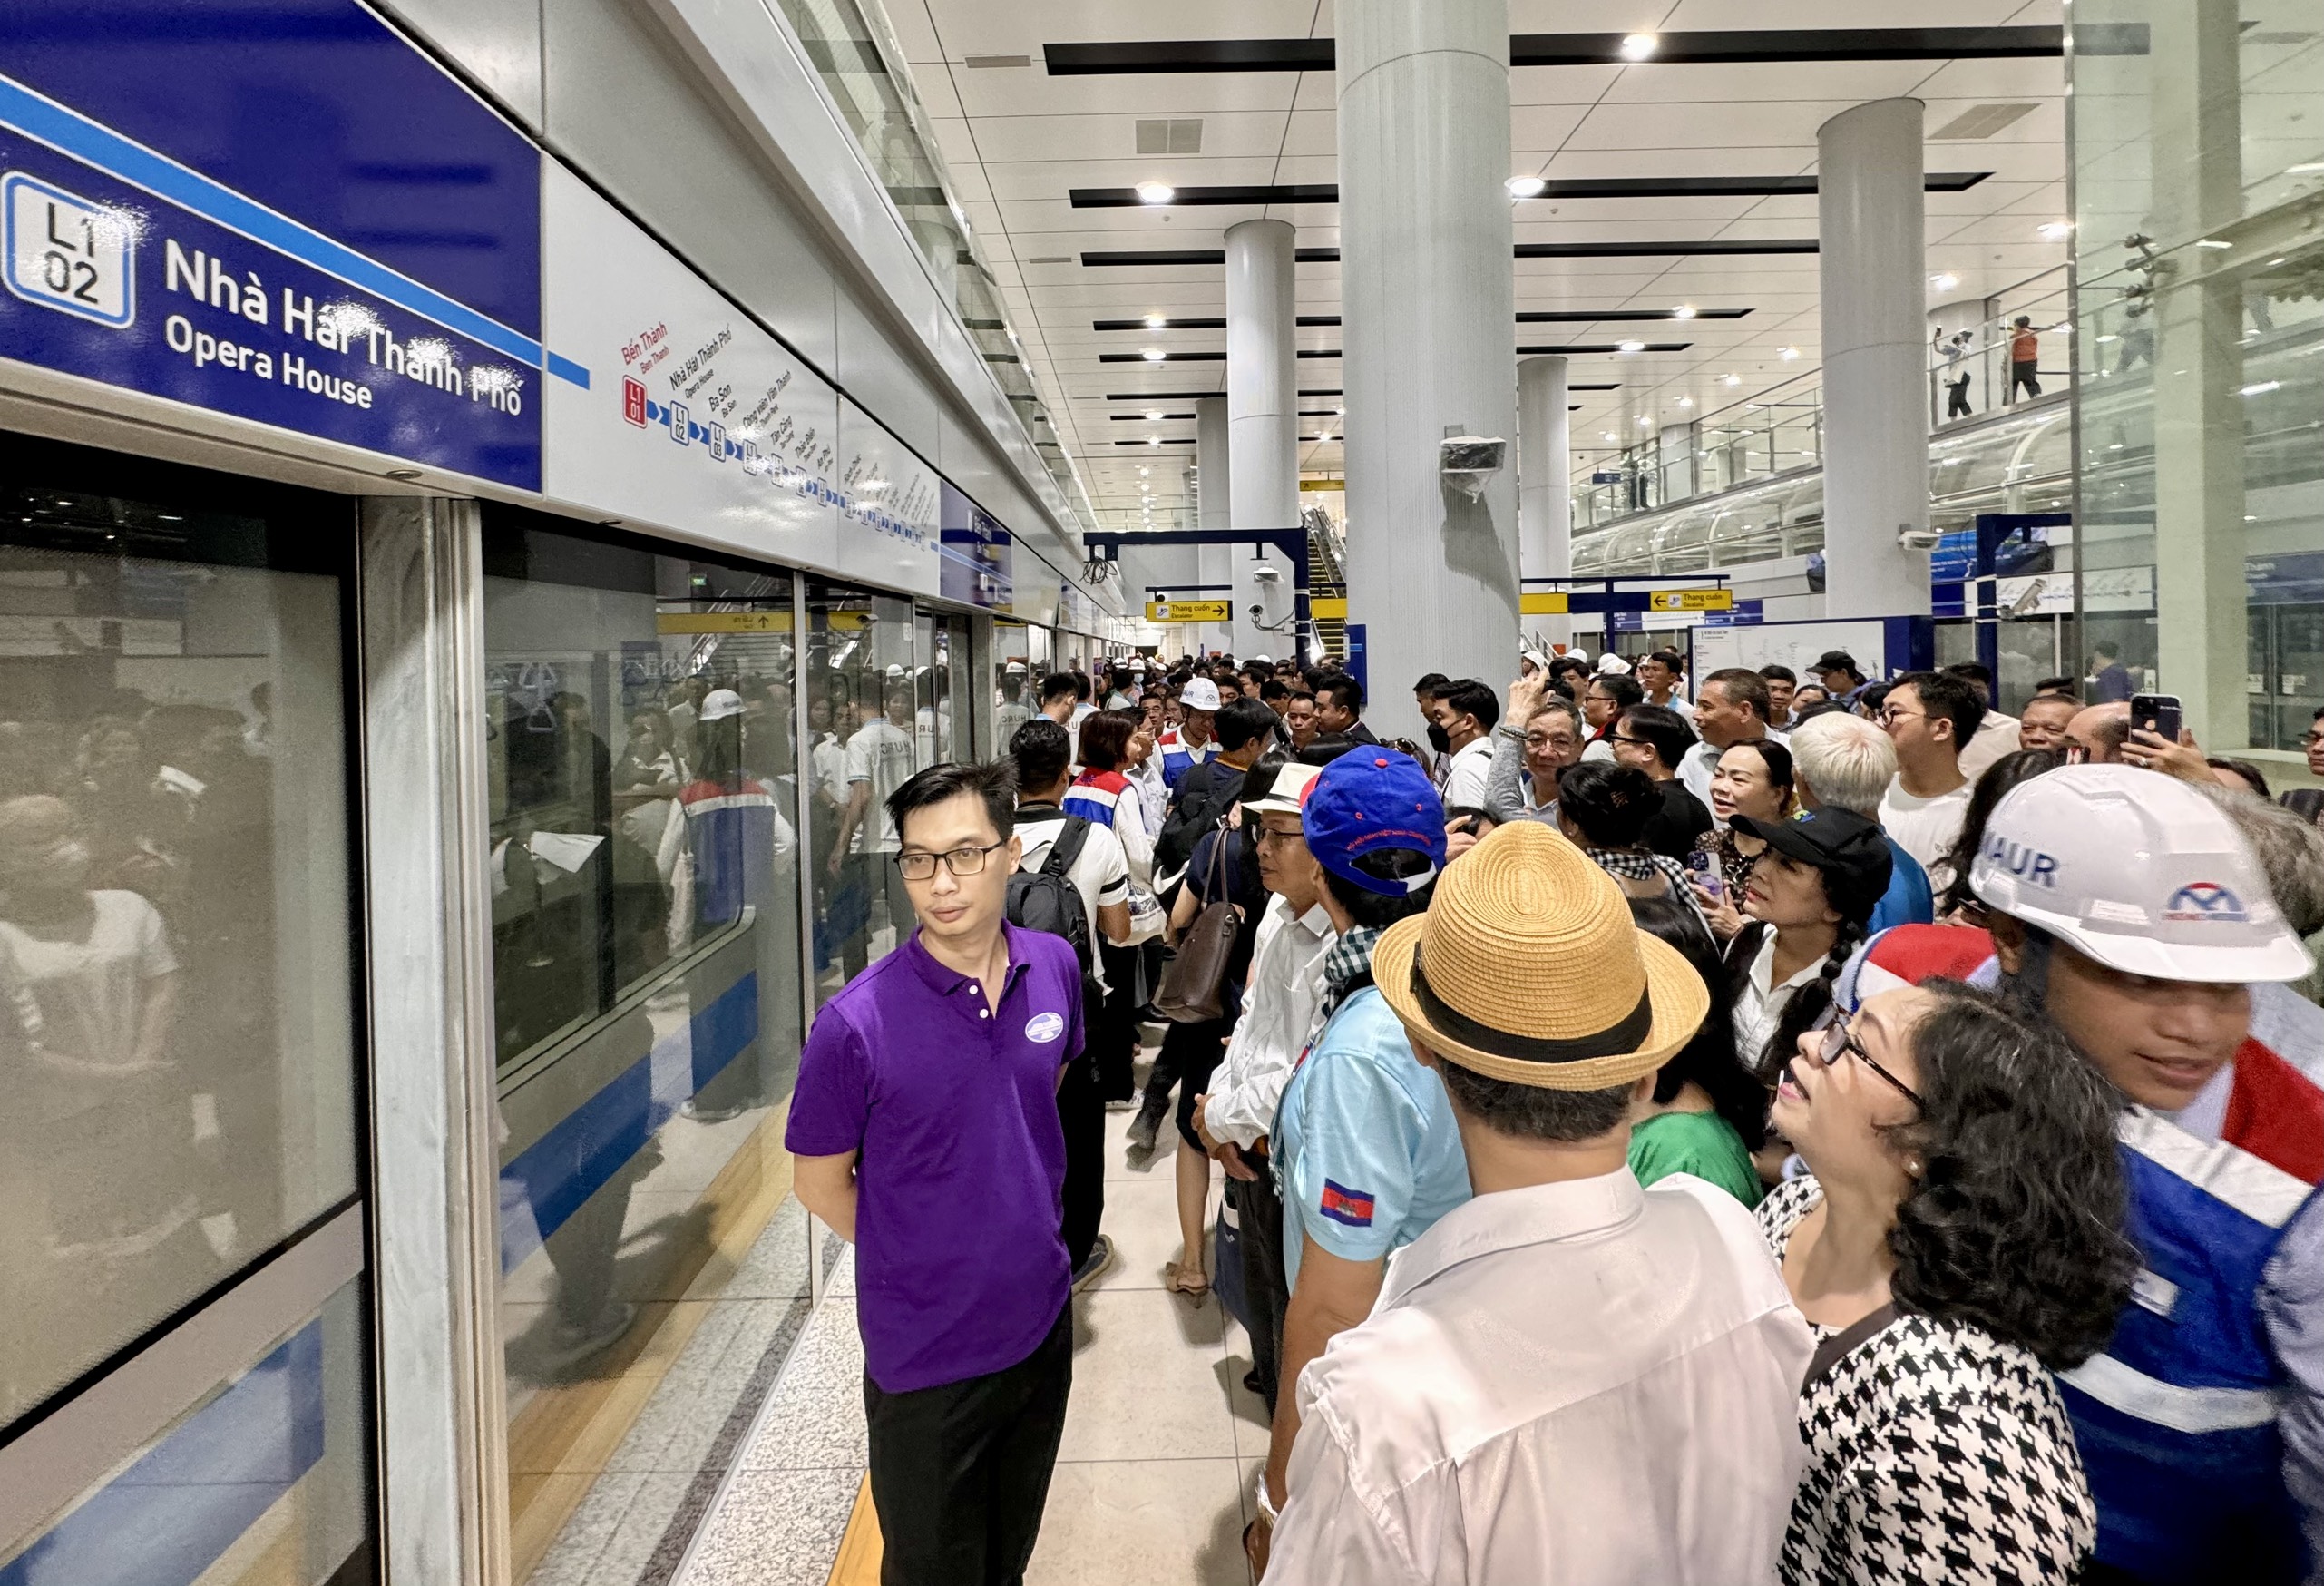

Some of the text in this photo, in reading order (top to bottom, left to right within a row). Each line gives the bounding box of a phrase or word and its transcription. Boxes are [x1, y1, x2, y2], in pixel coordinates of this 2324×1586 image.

[48, 201, 95, 258] L1
[44, 250, 98, 303] 02
[166, 238, 268, 325] Nhà
[621, 321, 668, 365] Bến Thành
[166, 315, 372, 408] Opera House
[669, 367, 687, 390] Nhà
[698, 338, 719, 365] Thành
[630, 384, 640, 403] L1
[630, 402, 640, 421] 01
[708, 396, 719, 412] Ba
[676, 407, 684, 424] L1
[676, 425, 685, 440] 02
[714, 426, 722, 442] L1
[1684, 592, 1723, 602] Thang cuốn
[1171, 603, 1210, 612] Thang cuốn
